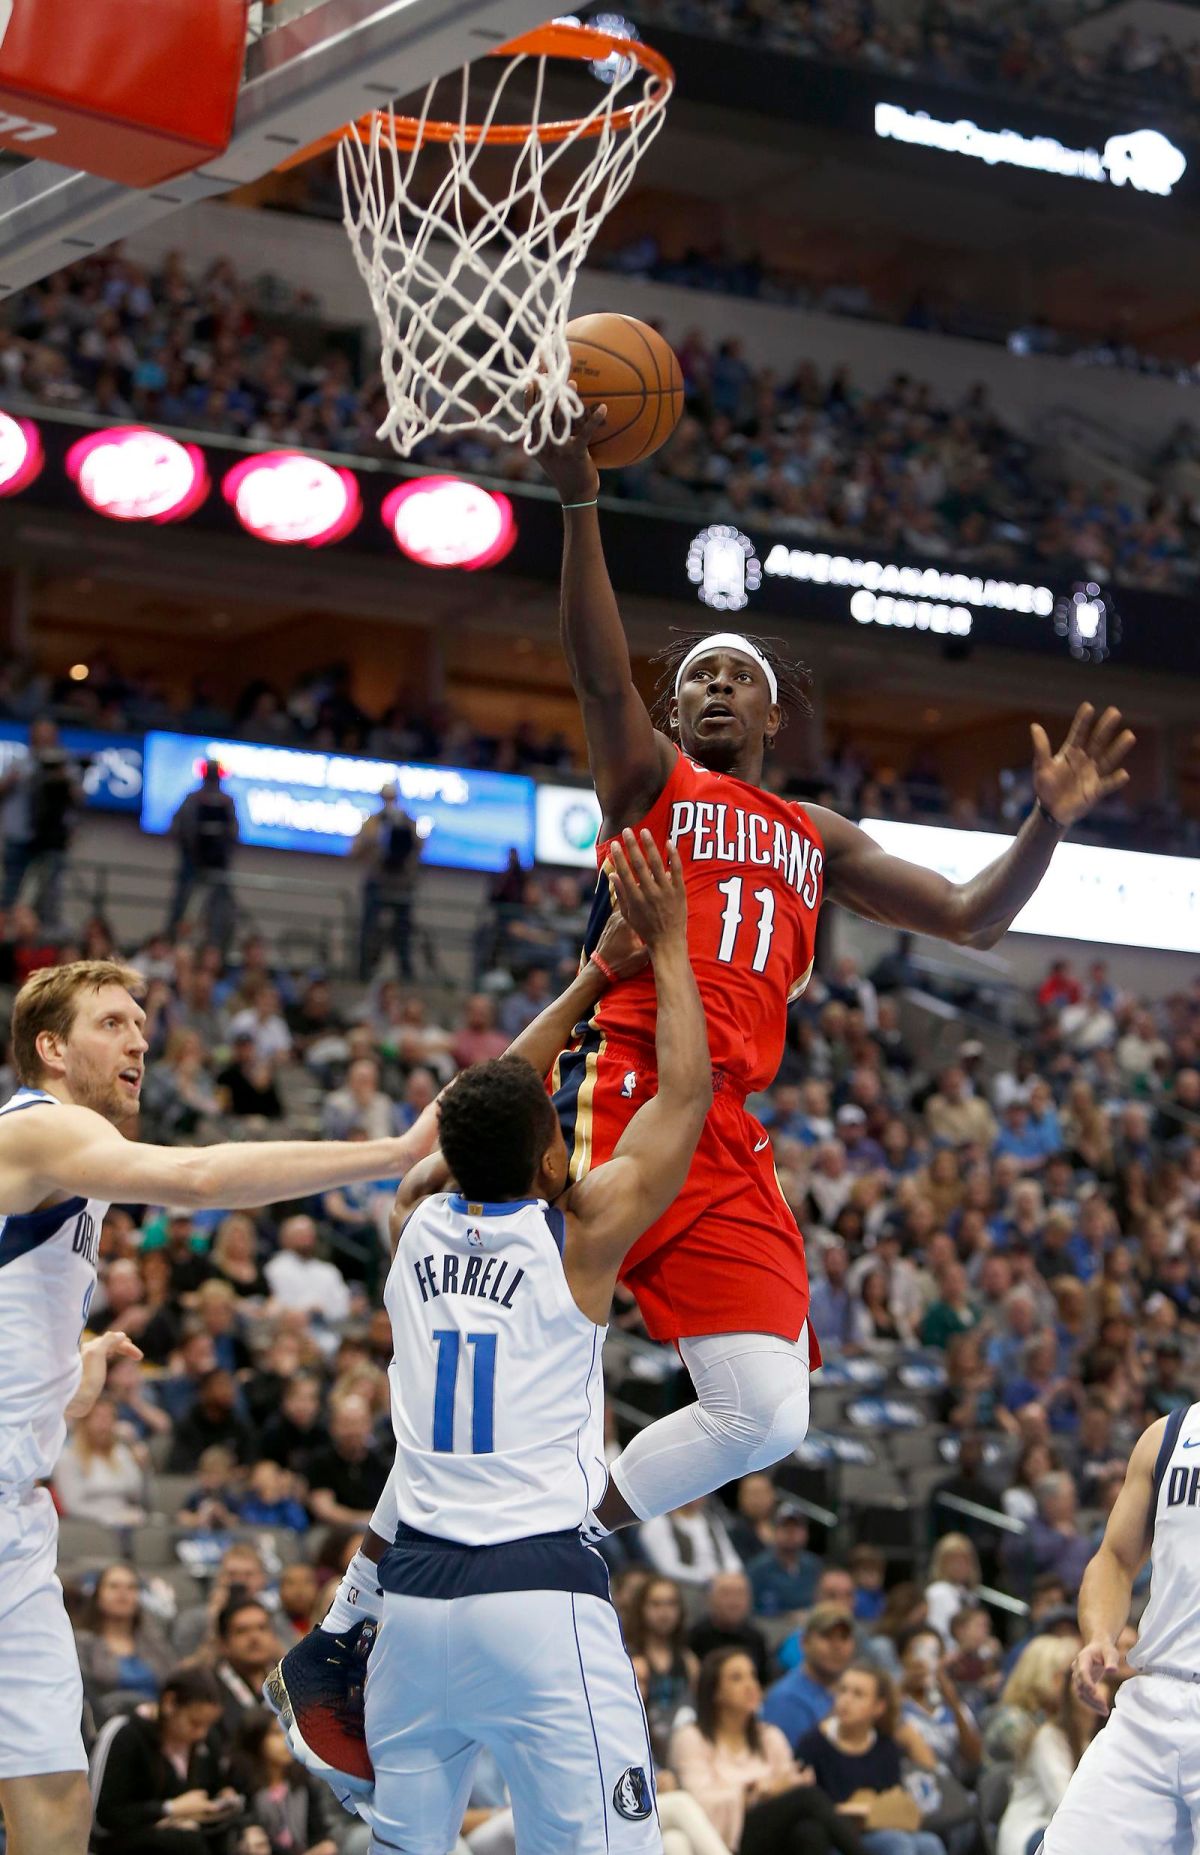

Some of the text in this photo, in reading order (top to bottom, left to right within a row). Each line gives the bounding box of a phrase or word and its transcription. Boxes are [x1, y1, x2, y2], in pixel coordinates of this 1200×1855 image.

[669, 800, 824, 911] PELICANS
[716, 874, 776, 975] 11
[413, 1253, 526, 1310] FERRELL
[432, 1329, 498, 1455] 11
